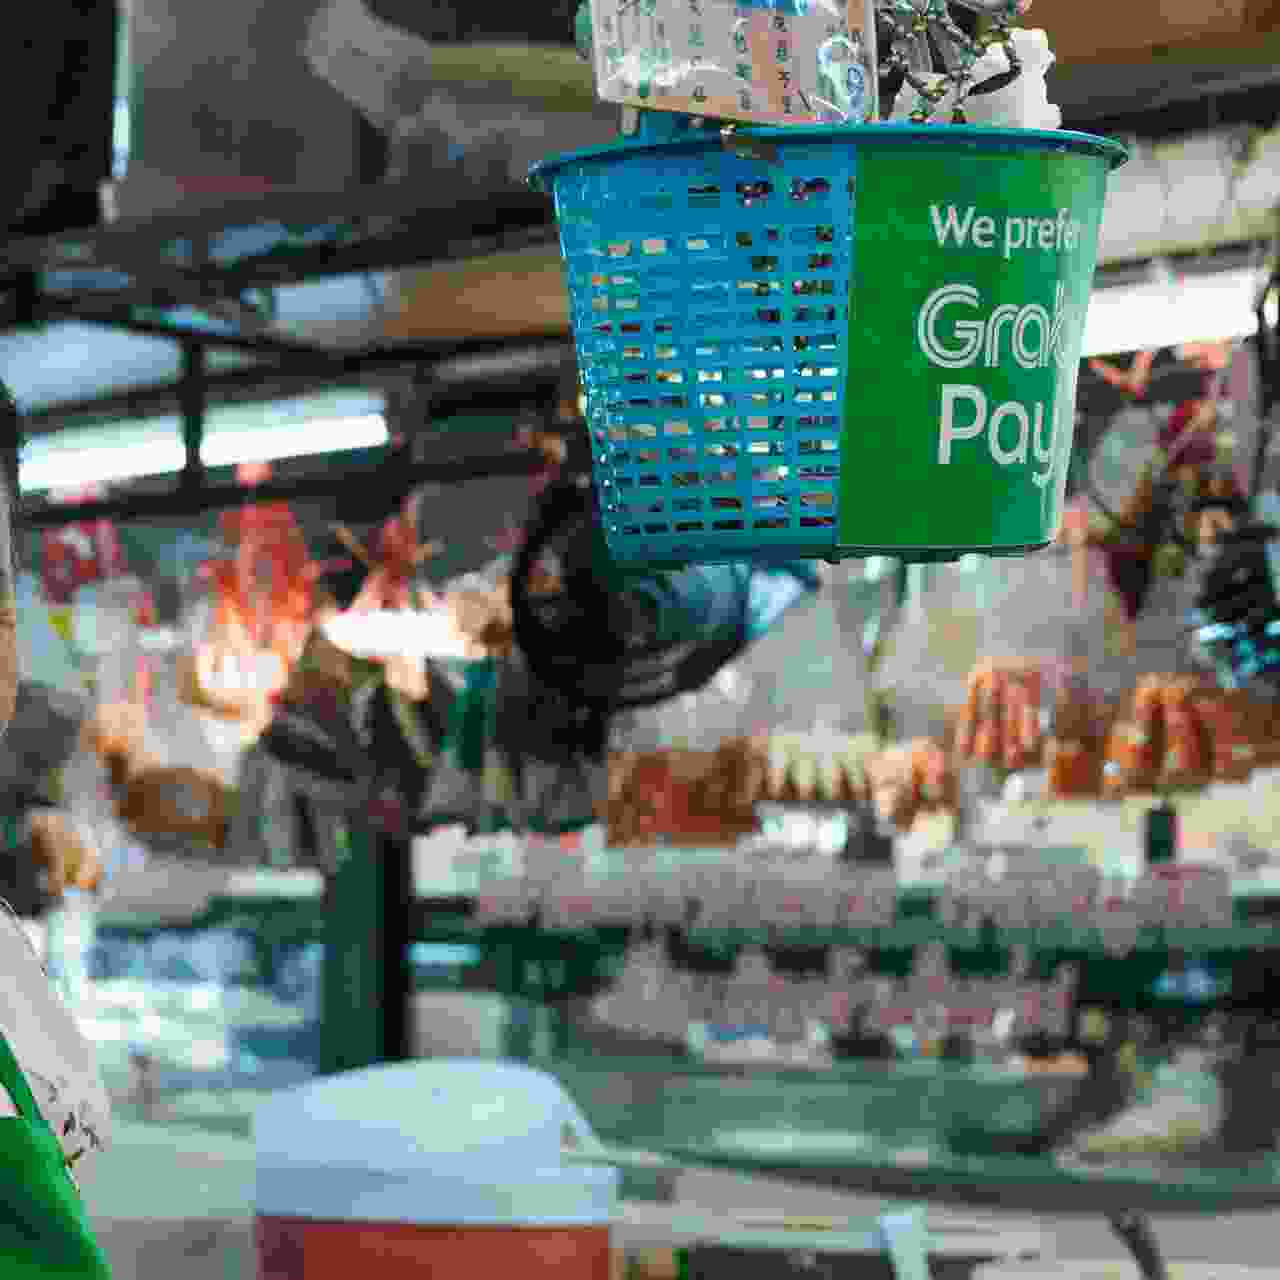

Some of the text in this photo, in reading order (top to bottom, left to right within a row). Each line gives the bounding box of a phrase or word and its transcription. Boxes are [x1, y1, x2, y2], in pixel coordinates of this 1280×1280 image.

[929, 204, 1083, 259] We prefe
[937, 384, 1056, 487] Pay
